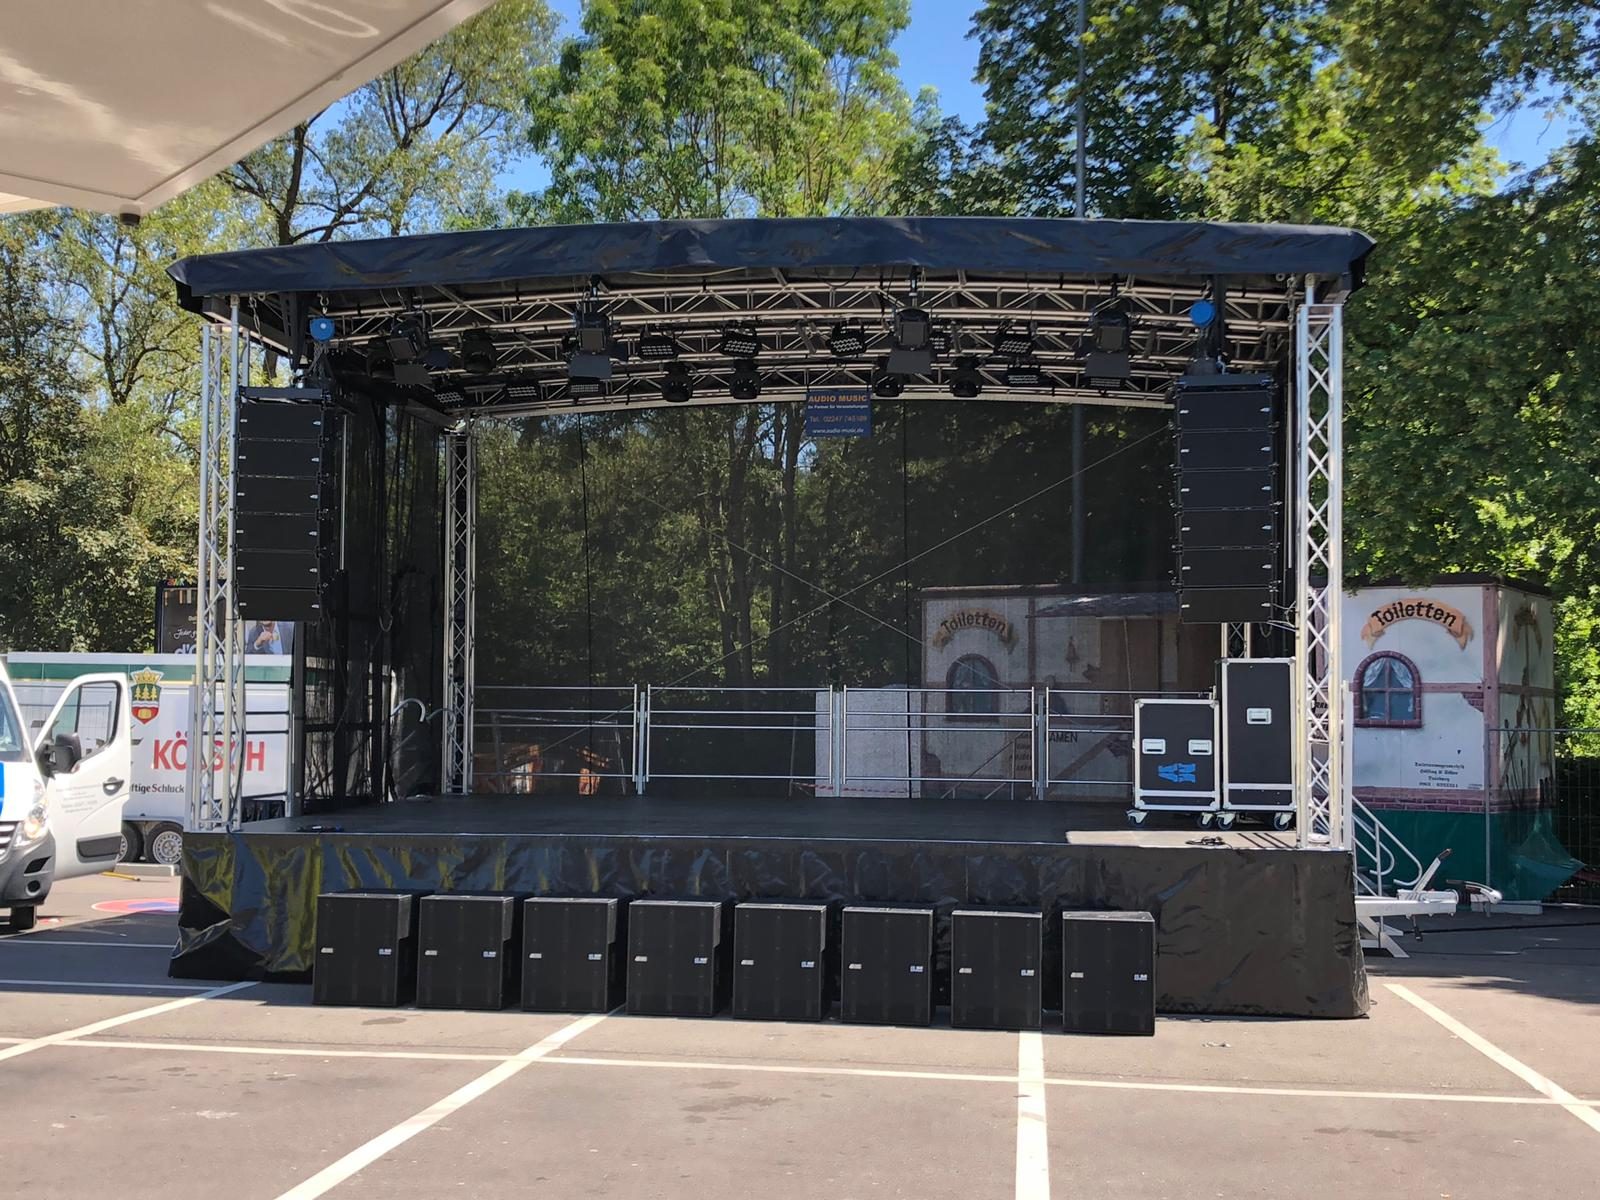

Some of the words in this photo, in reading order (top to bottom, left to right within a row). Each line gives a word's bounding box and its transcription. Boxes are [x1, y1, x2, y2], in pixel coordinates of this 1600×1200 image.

[940, 611, 1007, 634] Toiletten
[1370, 601, 1458, 627] Toiletten
[152, 731, 265, 772] KÖSH
[151, 783, 185, 793] Schluck
